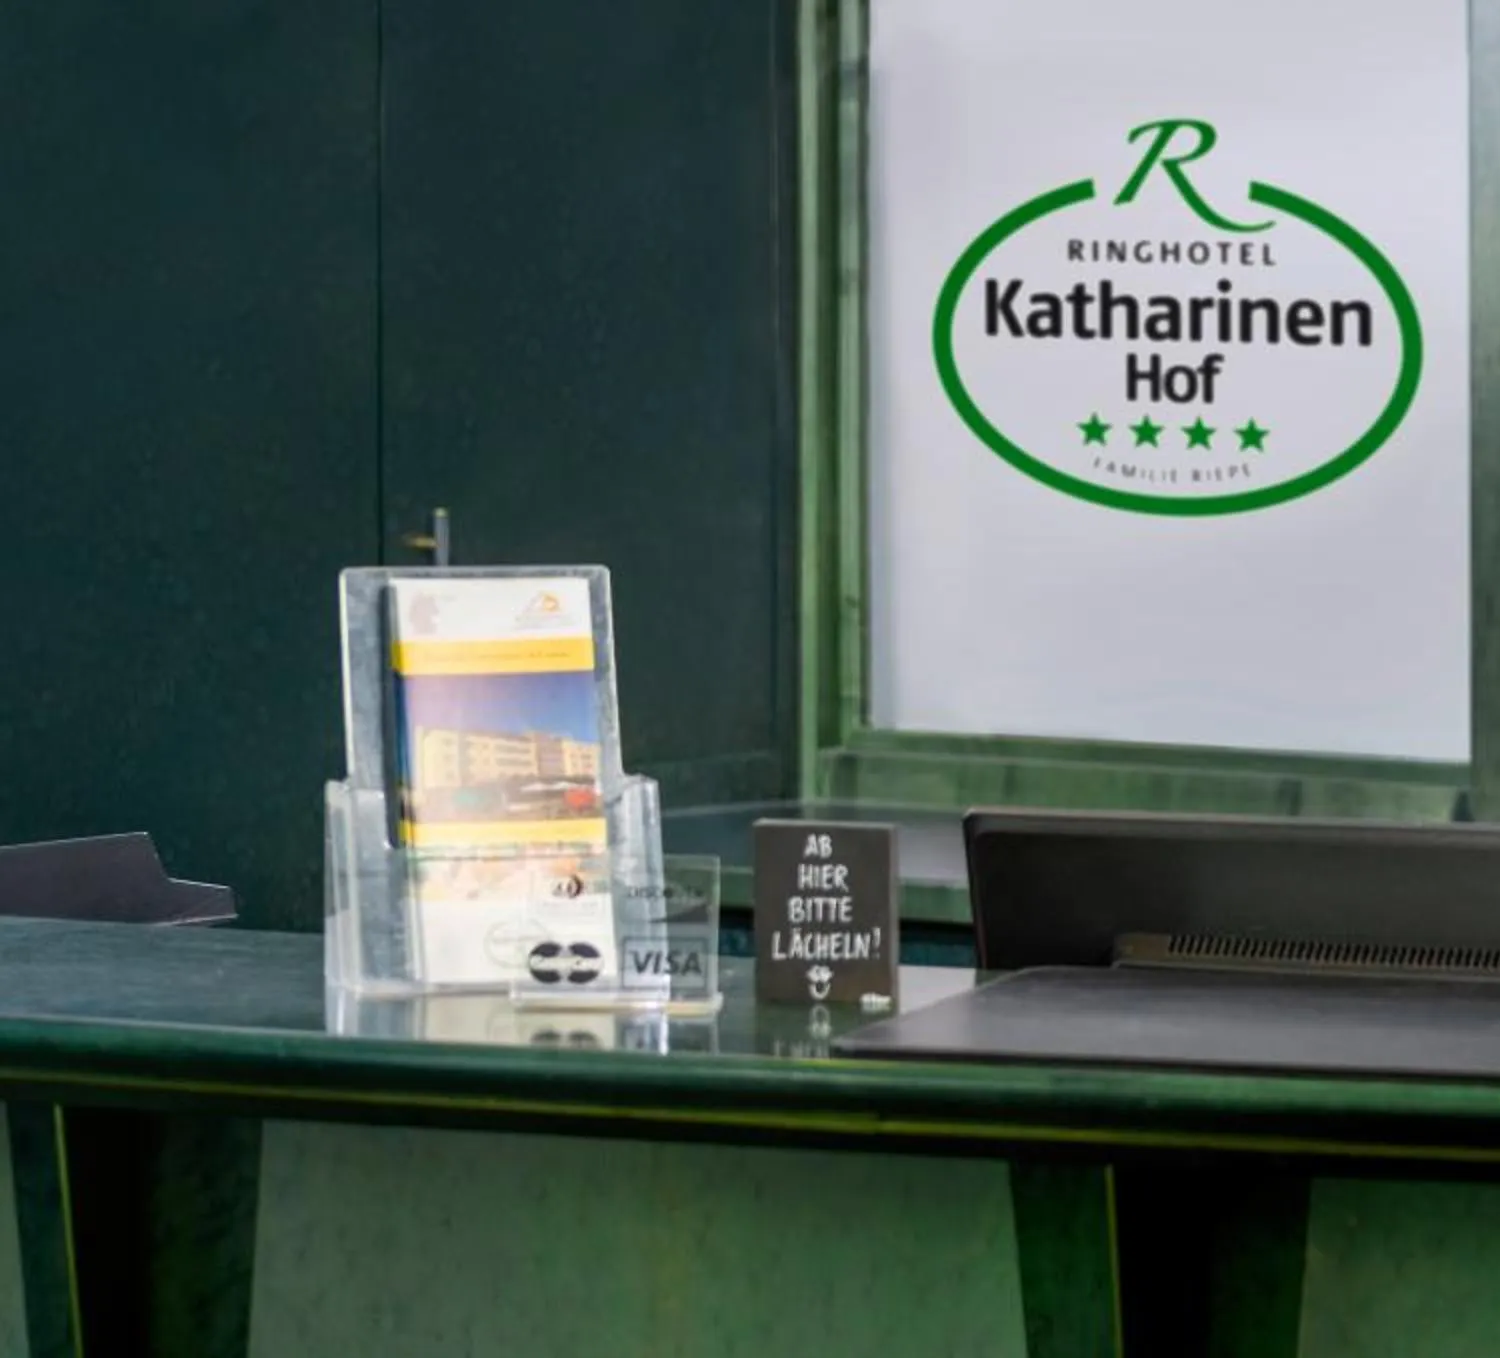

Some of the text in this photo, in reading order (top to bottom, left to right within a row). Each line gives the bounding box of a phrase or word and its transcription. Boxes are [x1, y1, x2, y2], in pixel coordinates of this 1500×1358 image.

[1067, 238, 1277, 267] RINGHOTEL
[984, 278, 1373, 347] Katharinen
[1125, 352, 1225, 405] Hof
[1093, 456, 1177, 483] FAMILIE
[804, 833, 833, 858] AB
[797, 863, 849, 891] HIER
[788, 896, 852, 923] BITTE
[771, 927, 881, 960] LÄCHELN!
[628, 949, 702, 976] VISA
